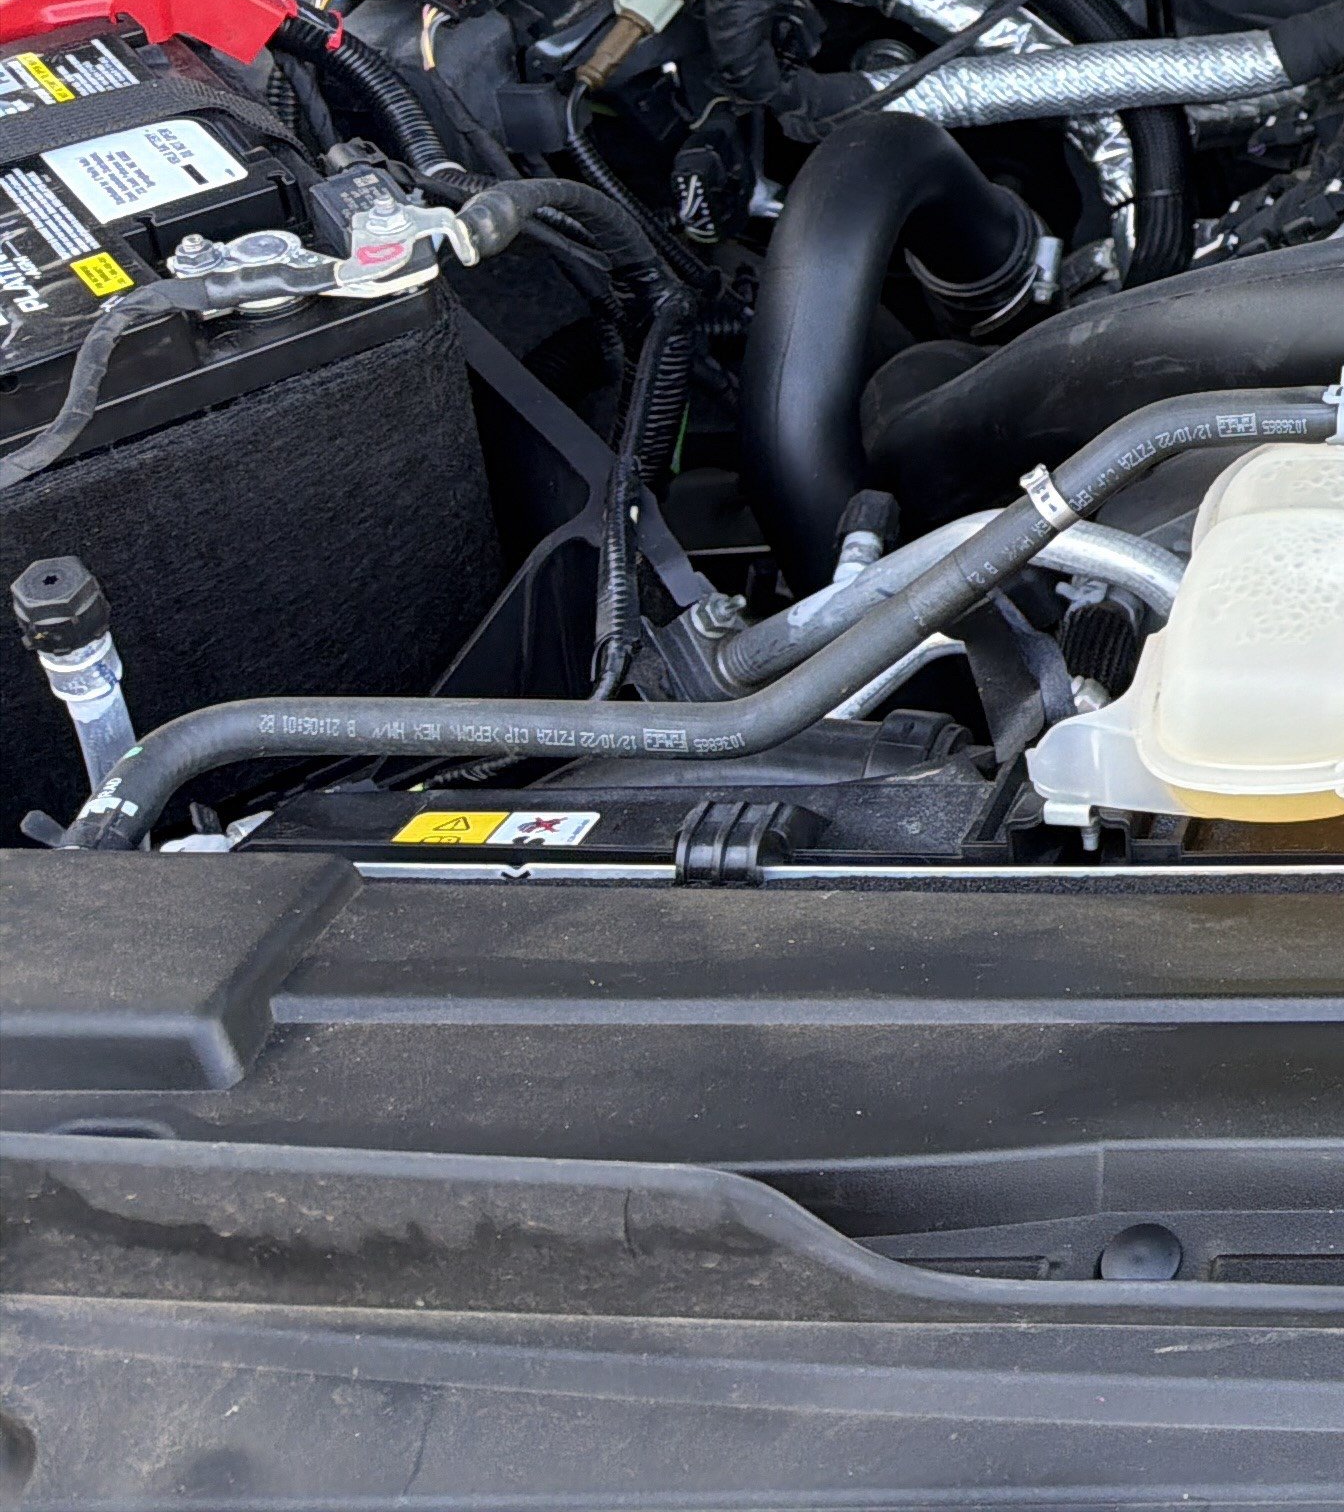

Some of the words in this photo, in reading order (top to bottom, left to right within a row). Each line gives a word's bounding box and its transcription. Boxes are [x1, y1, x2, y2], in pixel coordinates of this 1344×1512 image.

[1155, 422, 1212, 449] 12/10/22
[580, 731, 637, 751] 12/10/22
[692, 731, 746, 753] 1036865
